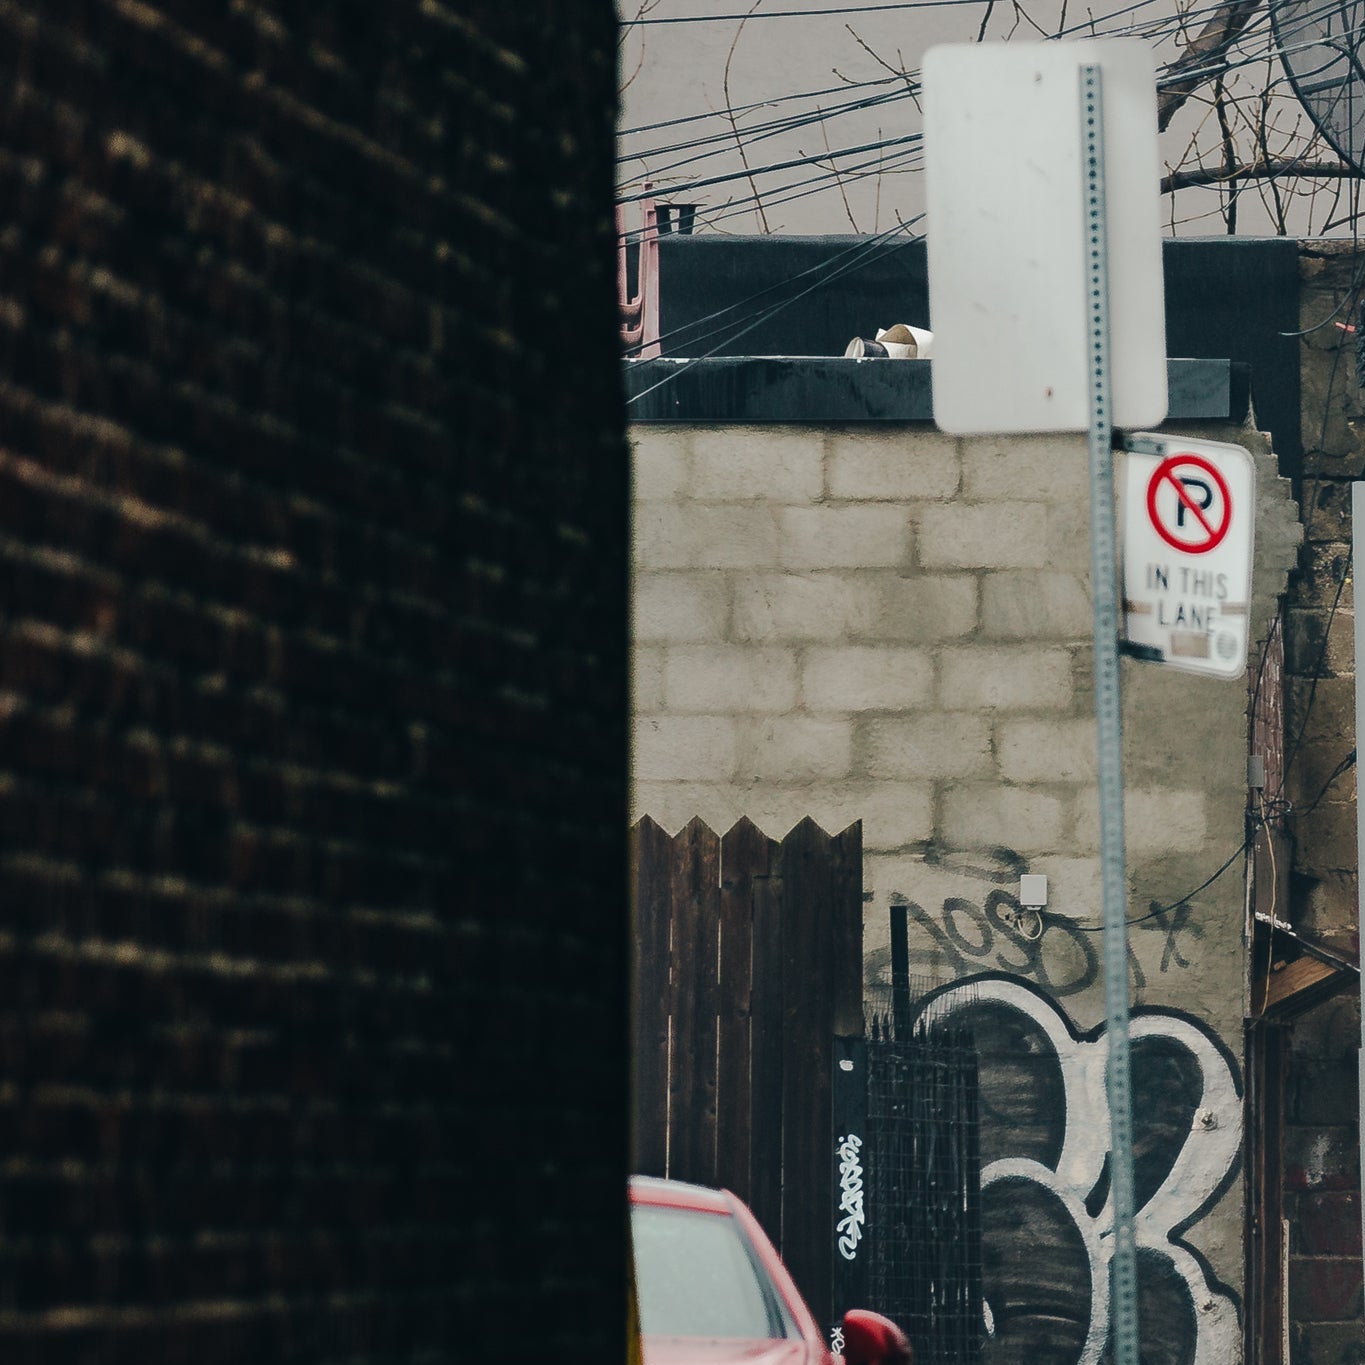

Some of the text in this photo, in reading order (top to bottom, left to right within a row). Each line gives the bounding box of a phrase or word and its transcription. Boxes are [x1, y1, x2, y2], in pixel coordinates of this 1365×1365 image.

[1176, 477, 1213, 527] P
[1146, 563, 1228, 600] IN THIS
[1158, 601, 1218, 635] LANE
